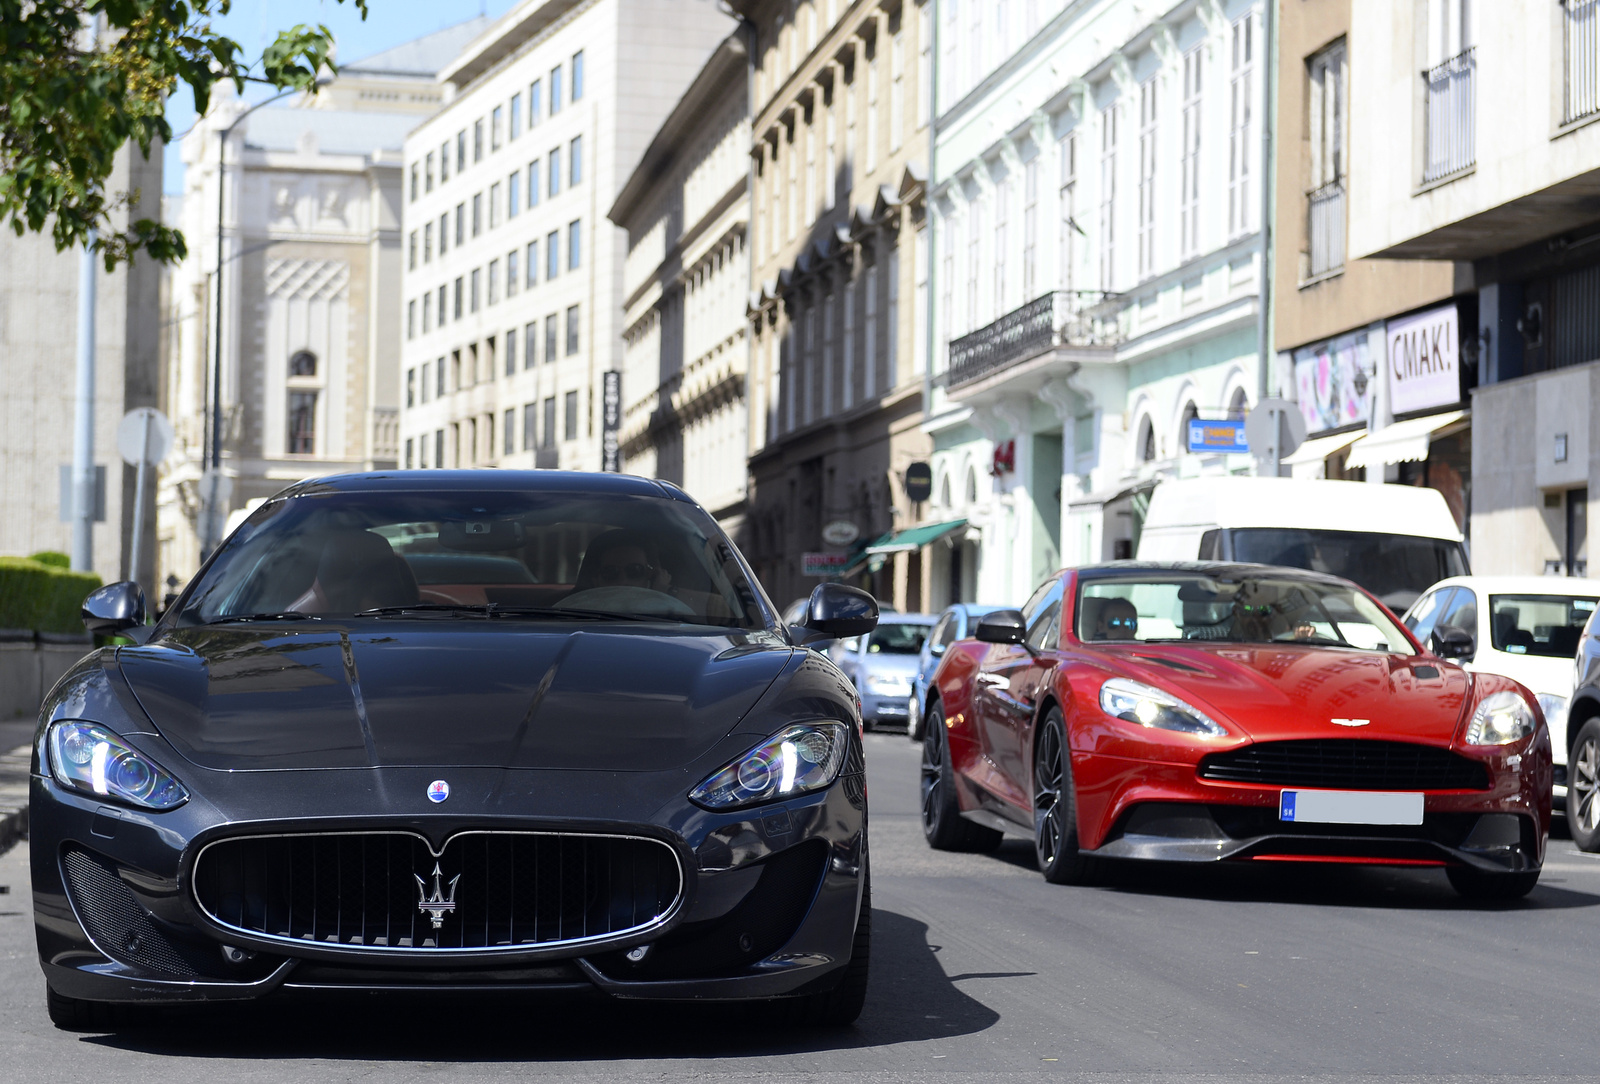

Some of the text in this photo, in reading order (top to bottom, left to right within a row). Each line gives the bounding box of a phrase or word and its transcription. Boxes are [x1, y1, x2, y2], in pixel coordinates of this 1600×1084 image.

[1393, 322, 1450, 379] CMAK!
[604, 430, 618, 471] HOTE
[1284, 808, 1293, 816] SK
